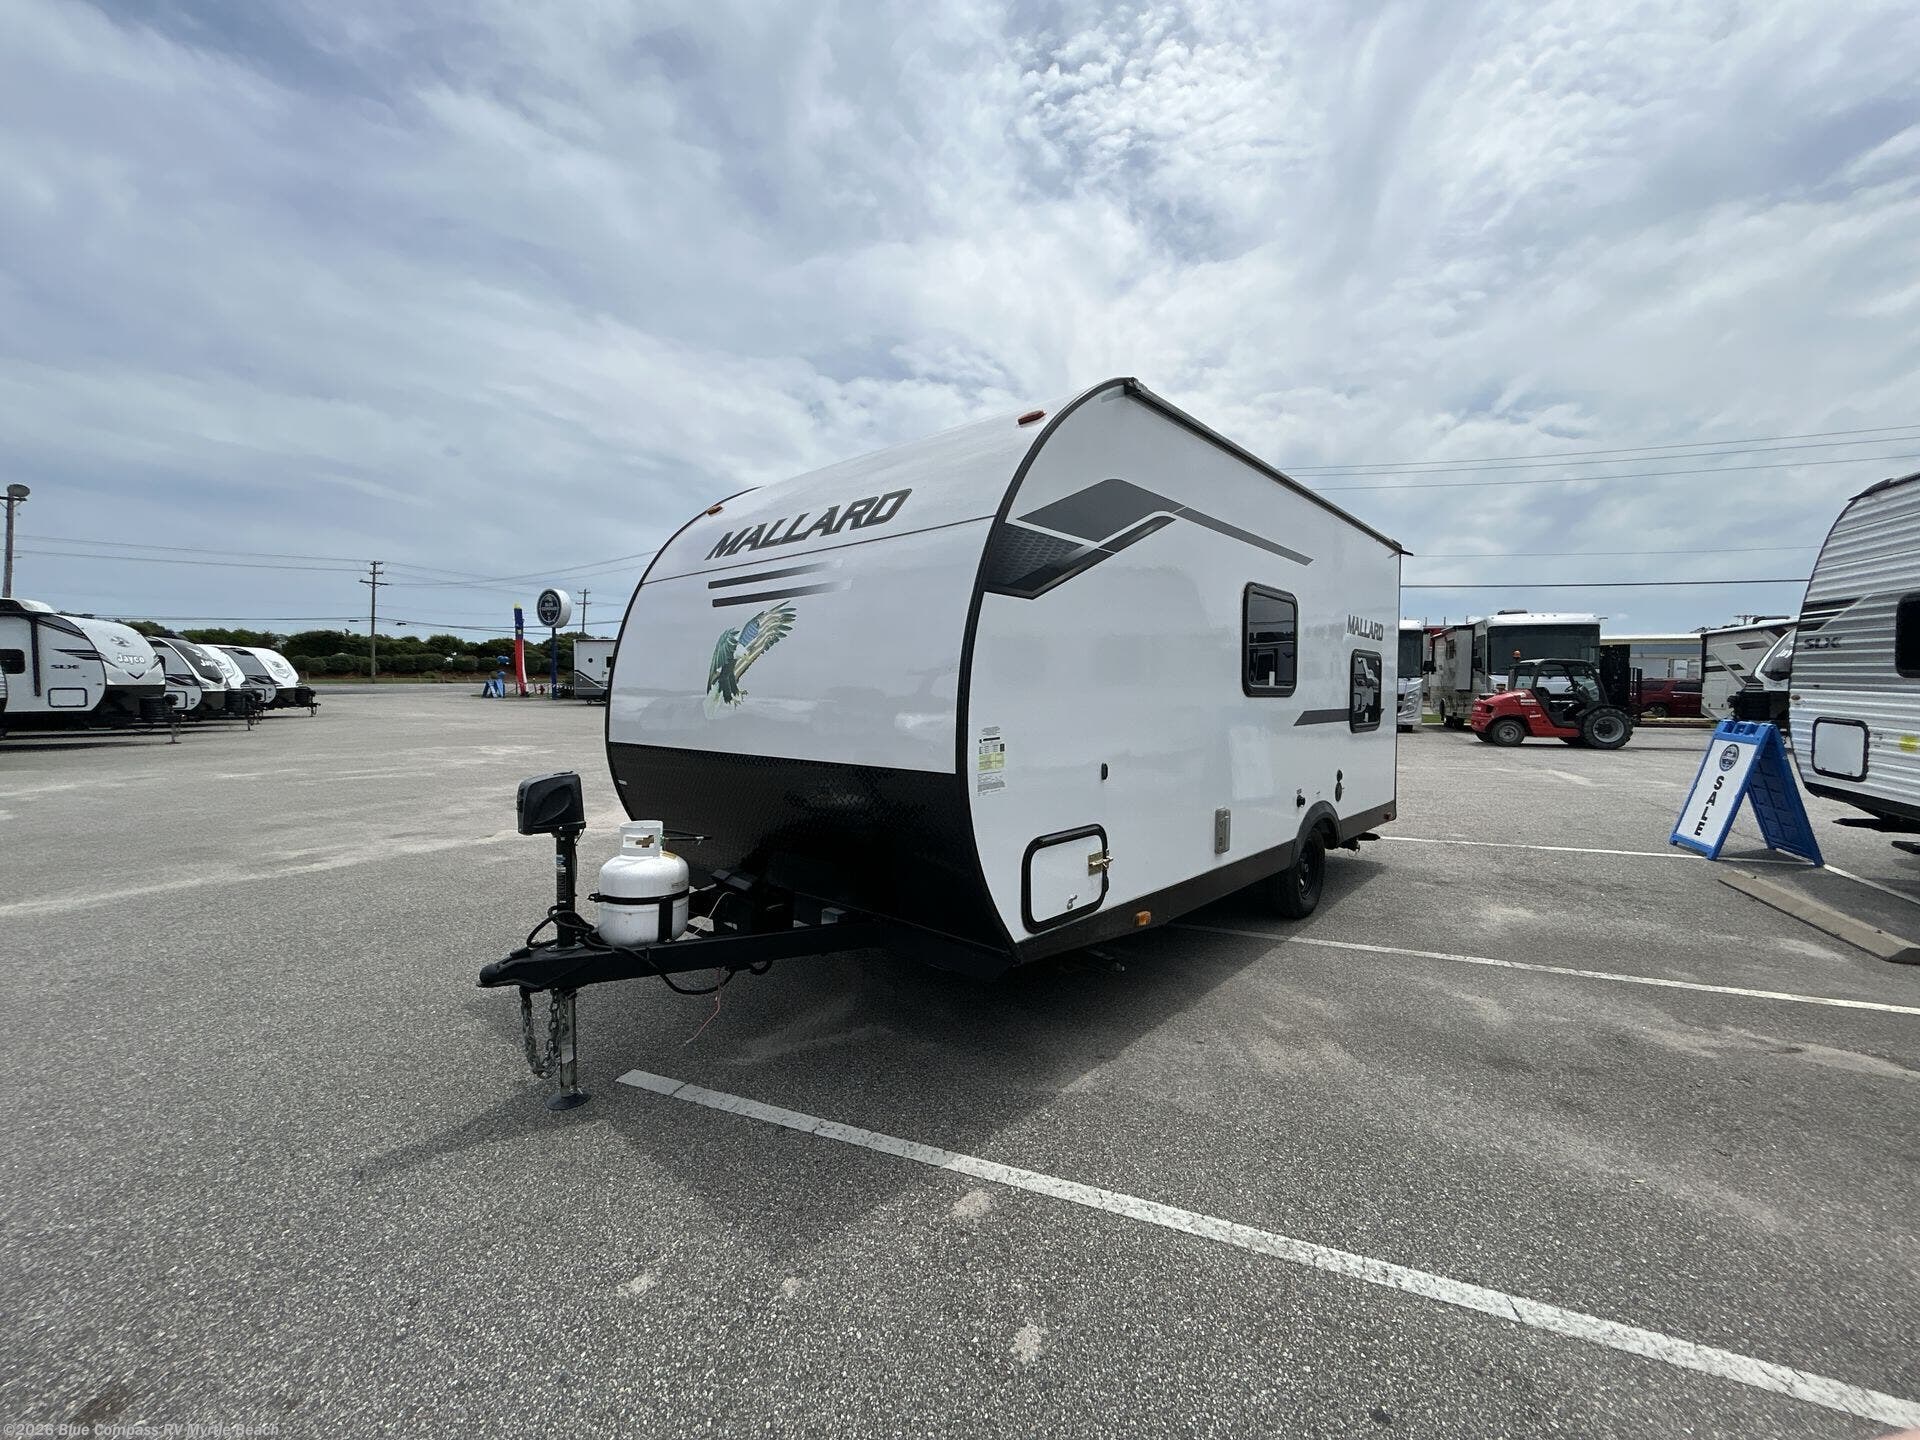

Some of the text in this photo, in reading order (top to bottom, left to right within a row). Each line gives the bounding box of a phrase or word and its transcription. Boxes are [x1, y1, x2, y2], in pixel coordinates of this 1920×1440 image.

[704, 488, 913, 561] MALLARD
[1346, 614, 1384, 642] MALLARD
[117, 654, 146, 665] Jayco
[1775, 648, 1793, 658] Jay
[1694, 775, 1725, 837] SALE
